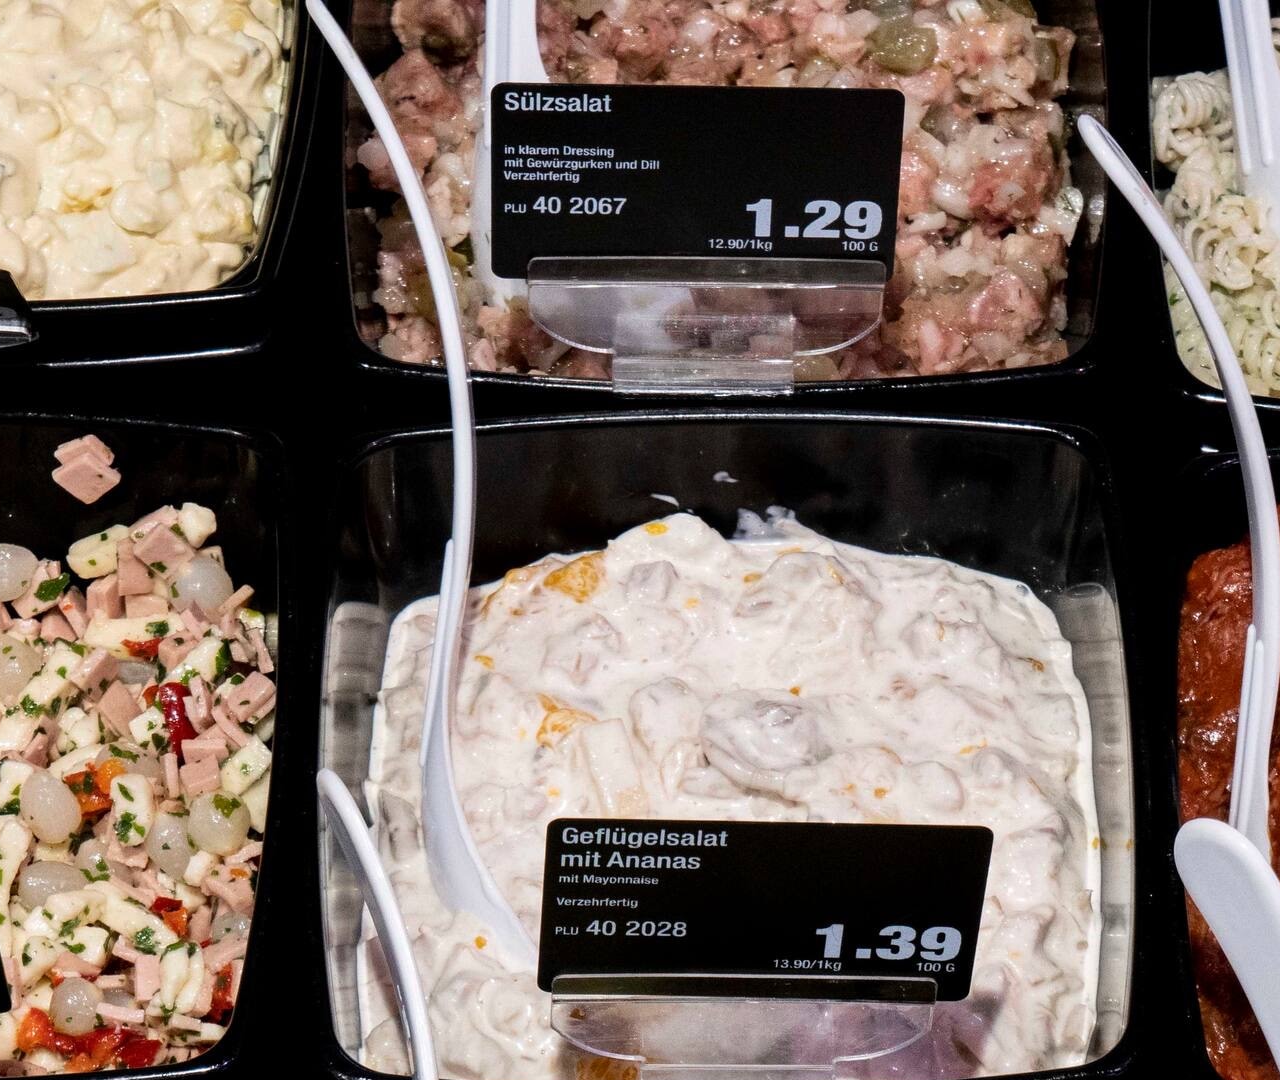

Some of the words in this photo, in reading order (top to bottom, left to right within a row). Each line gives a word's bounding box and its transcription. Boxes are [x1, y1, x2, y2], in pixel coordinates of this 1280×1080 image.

[504, 91, 612, 113] Sülzsalat
[504, 144, 515, 155] in
[518, 144, 560, 156] klarem
[562, 145, 615, 159] Dressing
[504, 157, 524, 168] mit
[526, 157, 612, 171] Gewürzgurken
[615, 159, 638, 170] und
[640, 159, 660, 170] Dill
[503, 170, 580, 184] Verzehrfertig
[504, 203, 527, 214] PLU
[532, 195, 562, 215] 40
[569, 196, 628, 215] 2067
[745, 198, 883, 240] 1.29
[708, 238, 773, 252] 12.90/1kg
[841, 240, 866, 252] 100
[868, 241, 879, 252] G
[561, 827, 729, 849] Geflügelsalat
[560, 850, 601, 868] mit
[606, 851, 701, 870] Ananas
[558, 874, 579, 884] mit
[582, 874, 659, 886] Mayonnaise
[556, 896, 639, 909] Verzehrfertig
[555, 926, 579, 936] PLU
[585, 919, 617, 936] 40
[625, 920, 687, 938] 2028
[815, 923, 962, 962] 1.39
[773, 959, 842, 972] 13.90/1kg
[916, 962, 942, 973] 100
[945, 962, 956, 973] G
